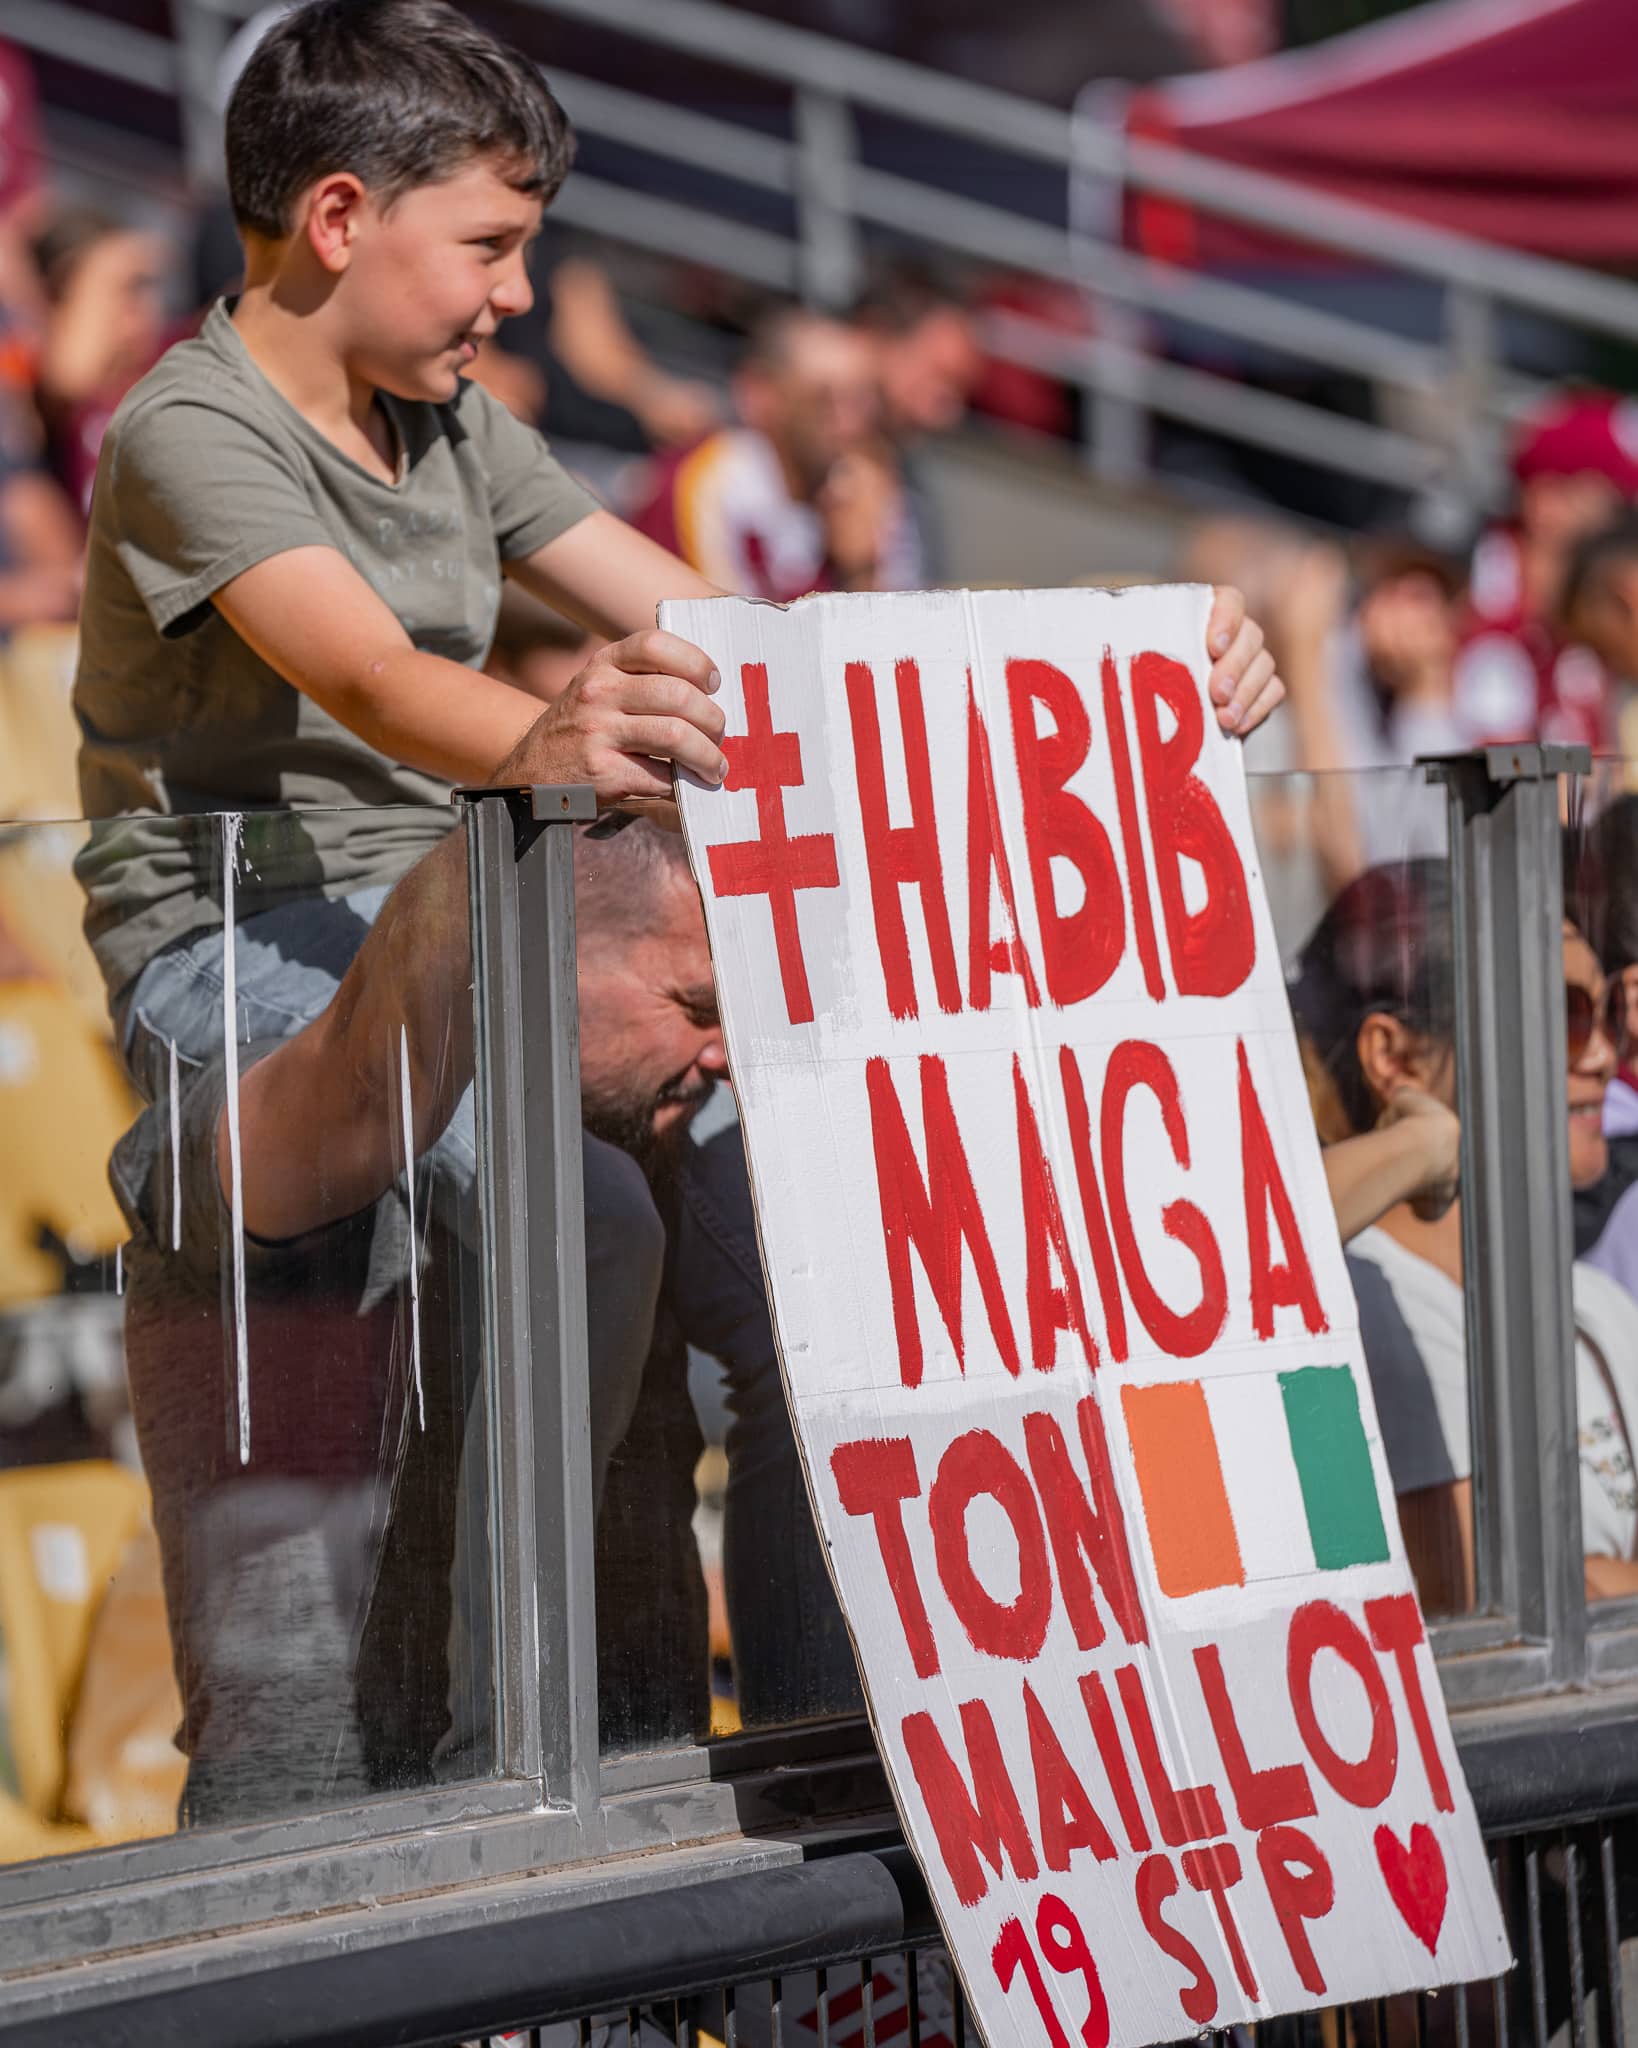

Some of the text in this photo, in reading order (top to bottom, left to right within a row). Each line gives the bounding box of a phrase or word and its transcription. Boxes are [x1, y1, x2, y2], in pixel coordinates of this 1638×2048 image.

[845, 645, 1256, 1021] HABIB
[866, 1036, 1328, 1388] MAIGA
[830, 1396, 1149, 1679] TON
[901, 1594, 1455, 1908] MAILLOT
[991, 1825, 1335, 2048] 19 STP
